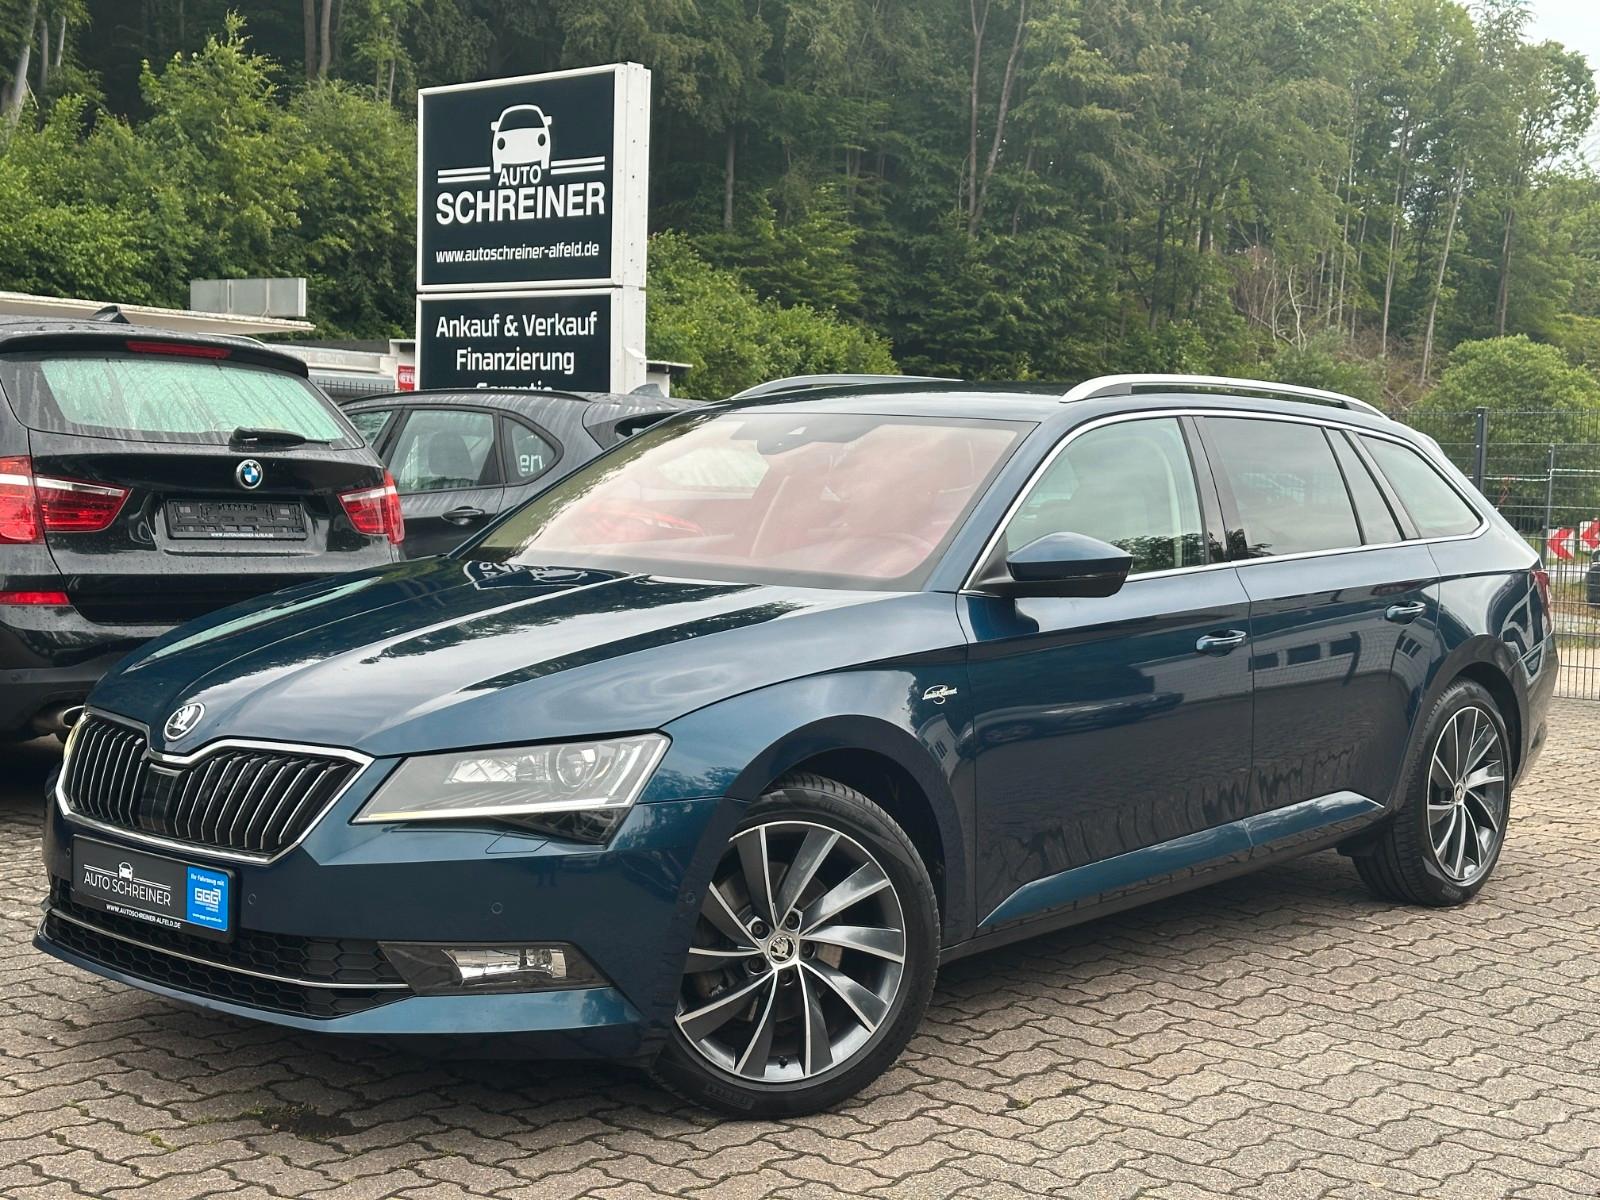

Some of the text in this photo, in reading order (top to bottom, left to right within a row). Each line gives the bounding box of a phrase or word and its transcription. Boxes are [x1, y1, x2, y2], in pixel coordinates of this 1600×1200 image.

[498, 165, 542, 187] AUTO
[436, 181, 605, 225] SCHREINER
[435, 241, 600, 263] www.autoschreiner-alfeld.de
[435, 311, 598, 338] Ankauf & Verkauf
[456, 347, 576, 375] Finanzierung
[84, 871, 110, 890] AUTO
[112, 879, 171, 907] SCHREINER
